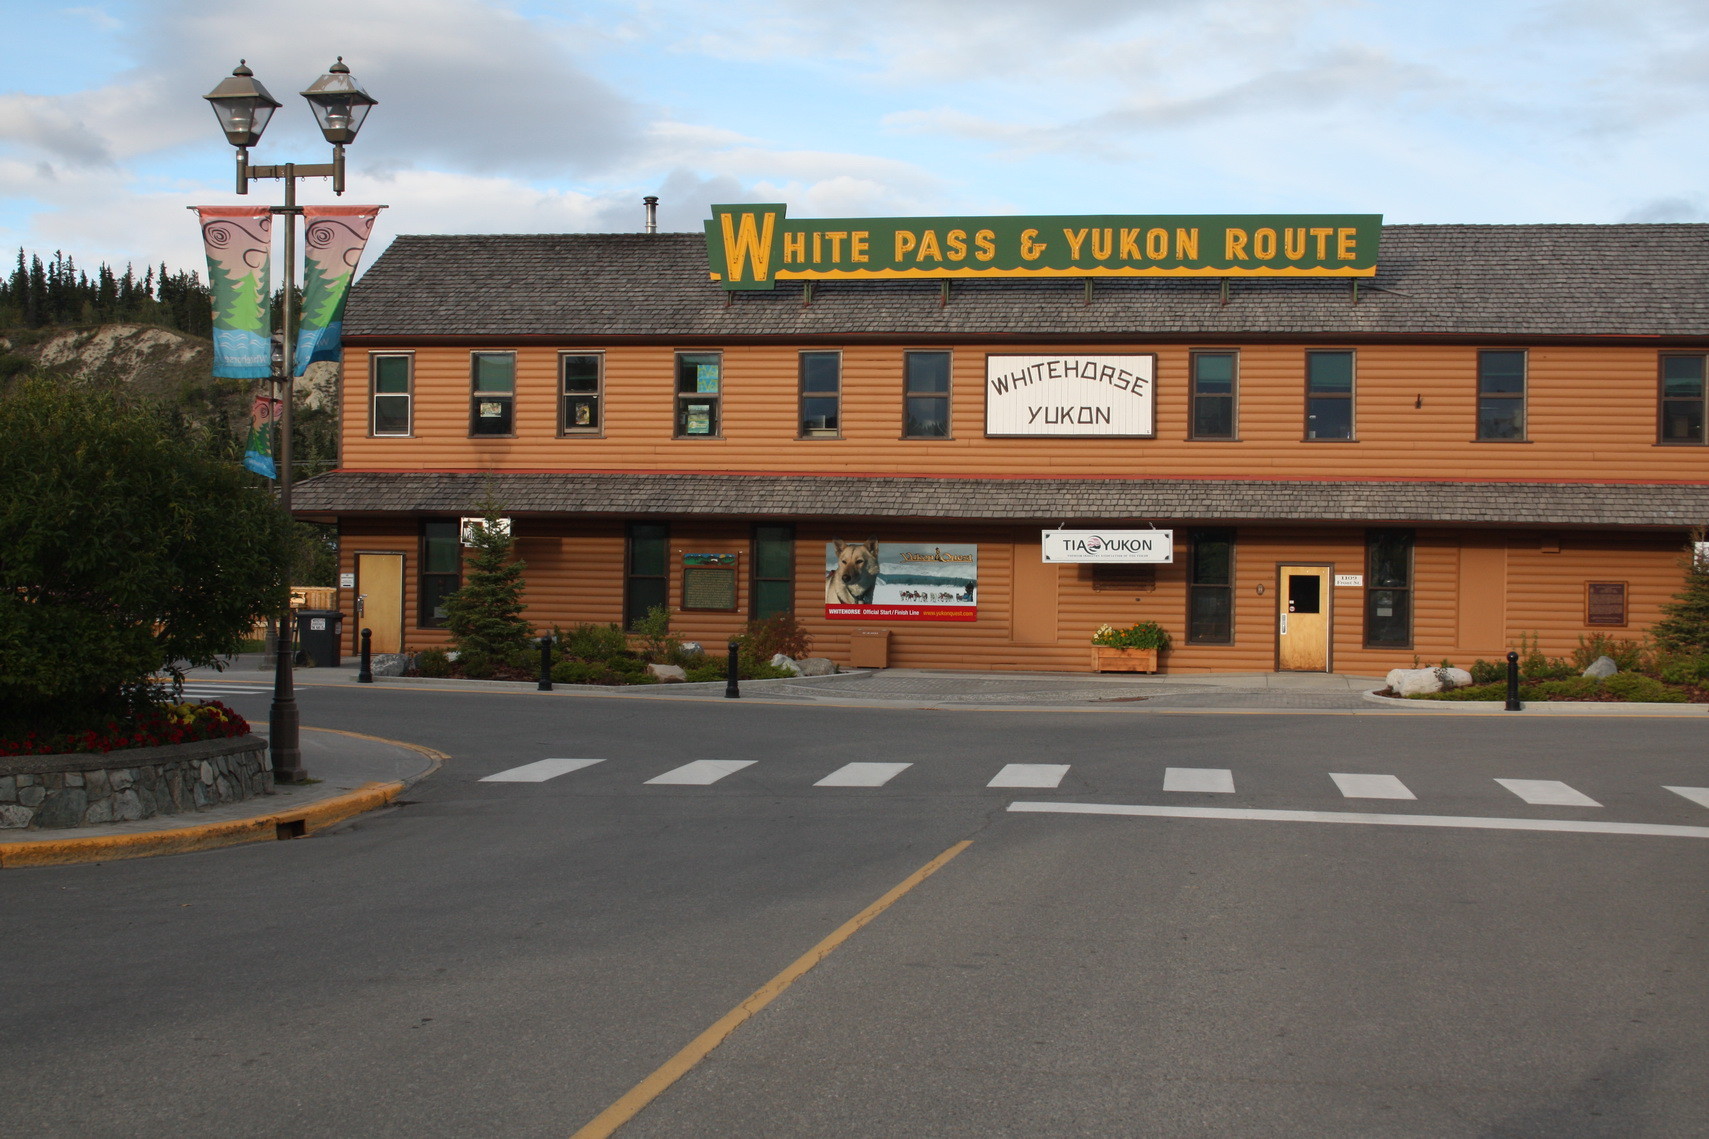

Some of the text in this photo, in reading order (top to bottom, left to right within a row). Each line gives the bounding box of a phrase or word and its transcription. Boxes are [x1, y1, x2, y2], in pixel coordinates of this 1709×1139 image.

[720, 212, 1357, 282] WHITE PASS & YUKON ROUTE
[991, 360, 1149, 397] WHITEHORSE
[1028, 406, 1111, 425] YUKON
[1062, 539, 1152, 553] TIA YUKON
